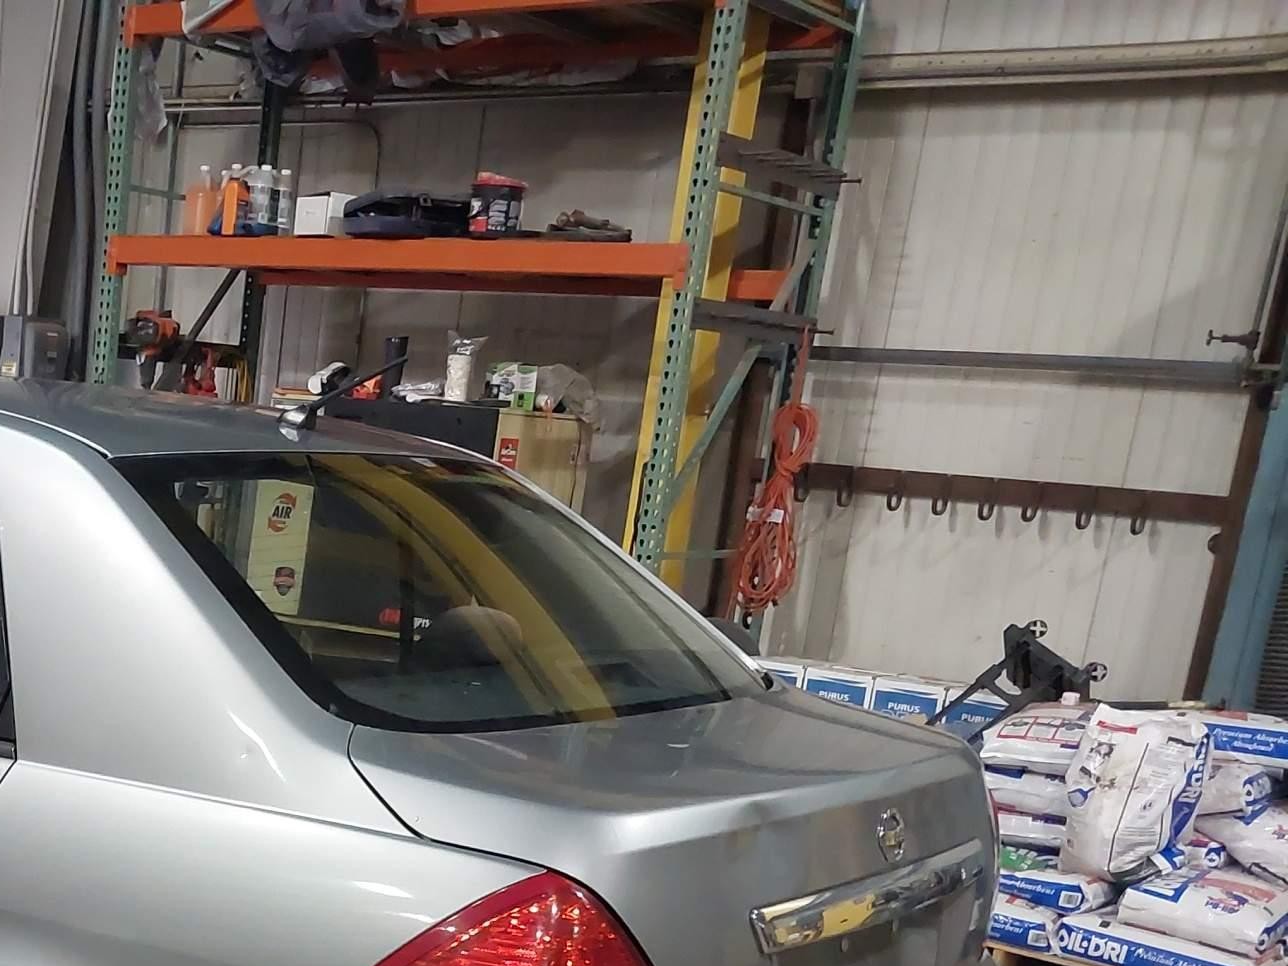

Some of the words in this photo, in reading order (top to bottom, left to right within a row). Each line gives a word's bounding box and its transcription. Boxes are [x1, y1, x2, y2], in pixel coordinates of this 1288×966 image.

[272, 505, 293, 519] AIR
[818, 690, 850, 702] PURUS
[887, 701, 921, 713] PURUS
[961, 712, 994, 723] PURU
